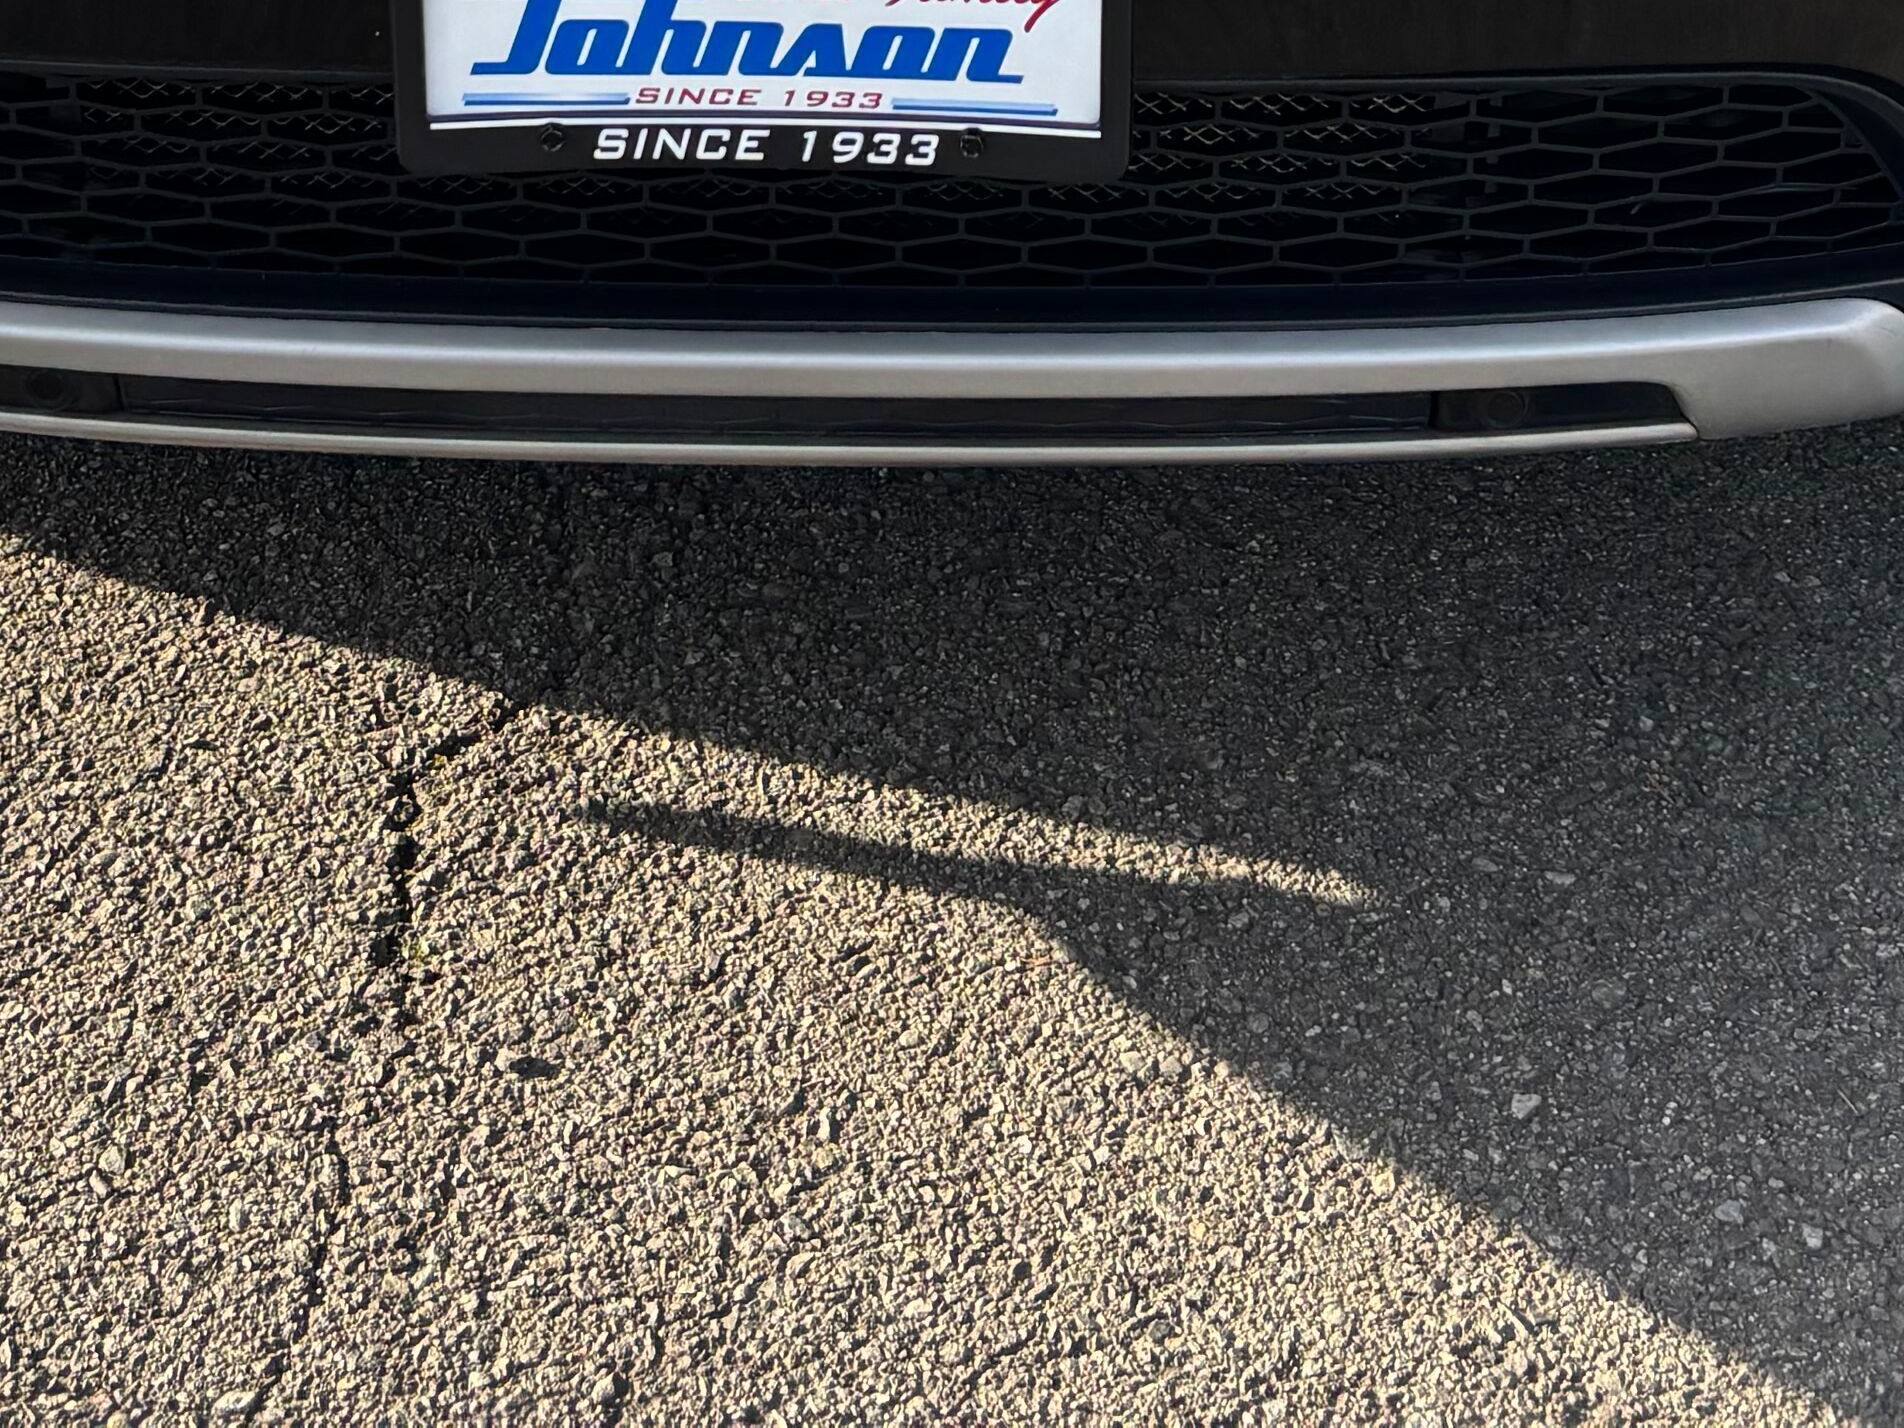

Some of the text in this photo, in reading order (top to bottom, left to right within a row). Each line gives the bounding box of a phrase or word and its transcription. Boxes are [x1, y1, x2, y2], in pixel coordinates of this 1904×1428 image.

[635, 87, 884, 109] SINCE 1933
[593, 127, 941, 166] SINCE 1933
